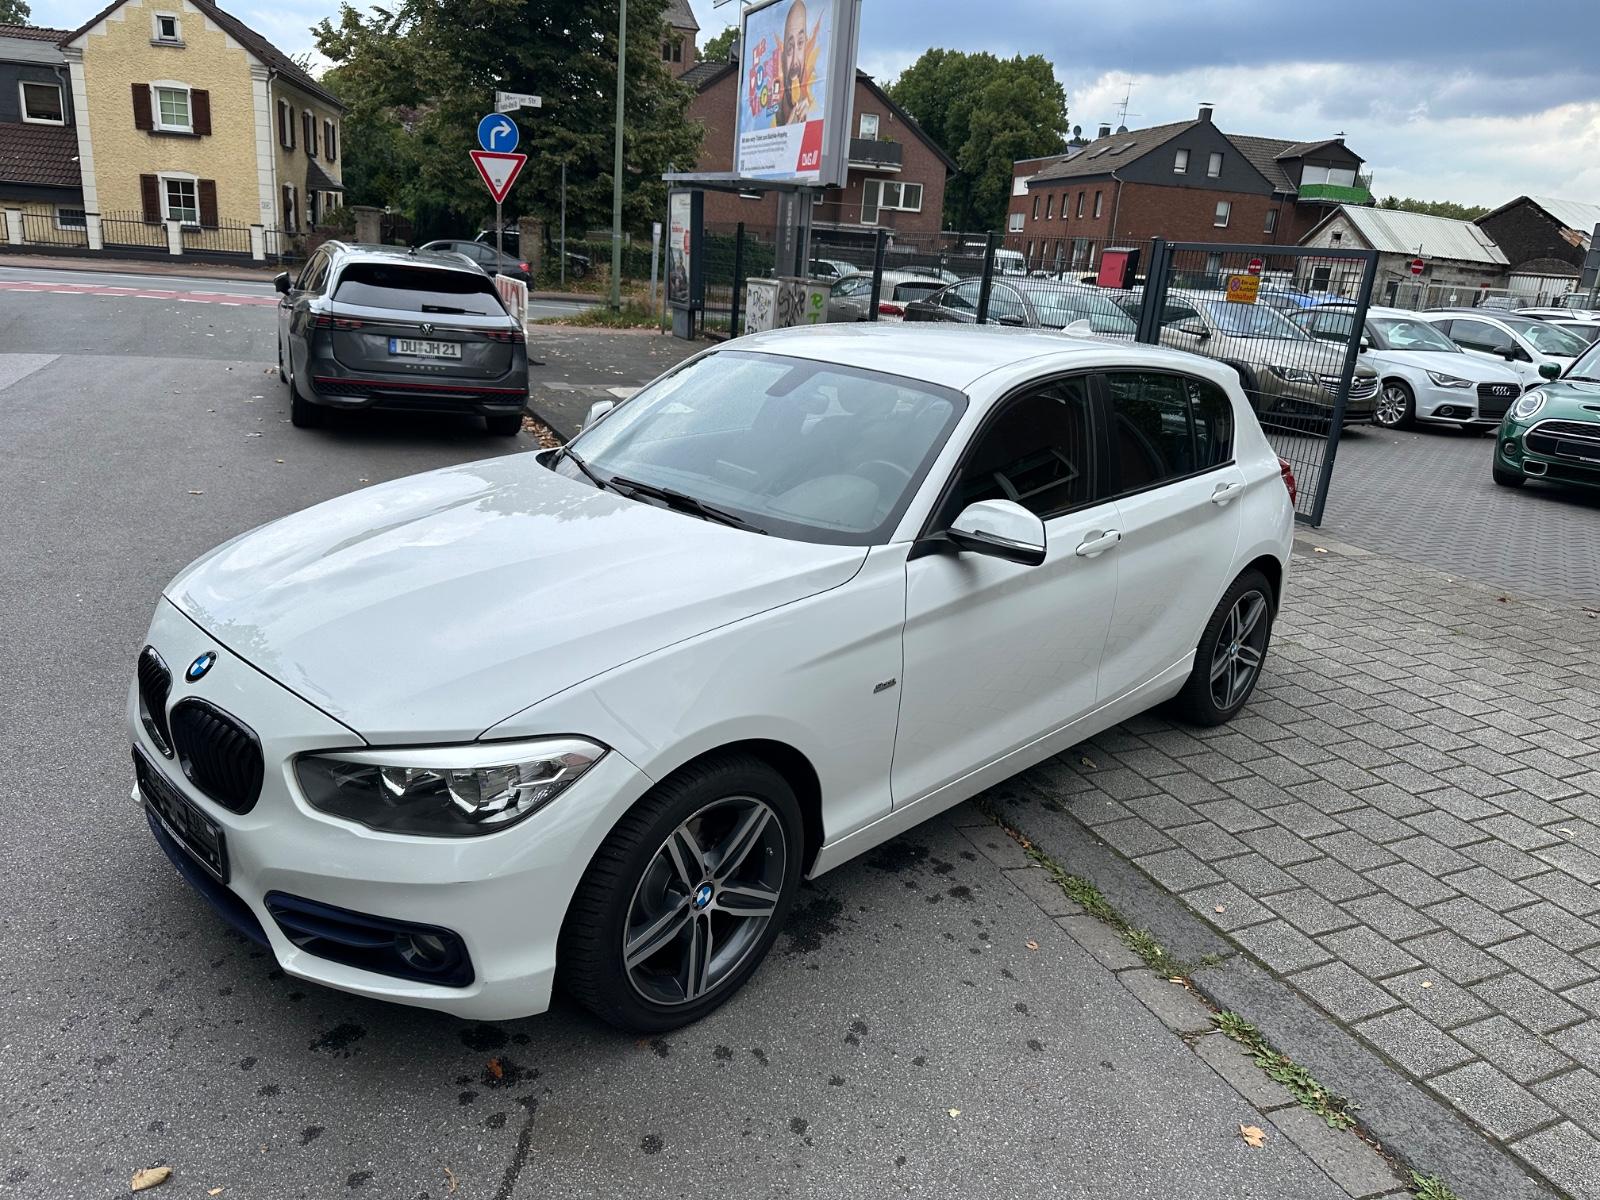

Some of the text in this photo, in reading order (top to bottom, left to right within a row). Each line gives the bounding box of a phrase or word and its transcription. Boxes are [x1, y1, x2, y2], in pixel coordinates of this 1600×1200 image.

[400, 340, 417, 353] DU
[424, 342, 440, 355] JH
[442, 343, 457, 356] 21
